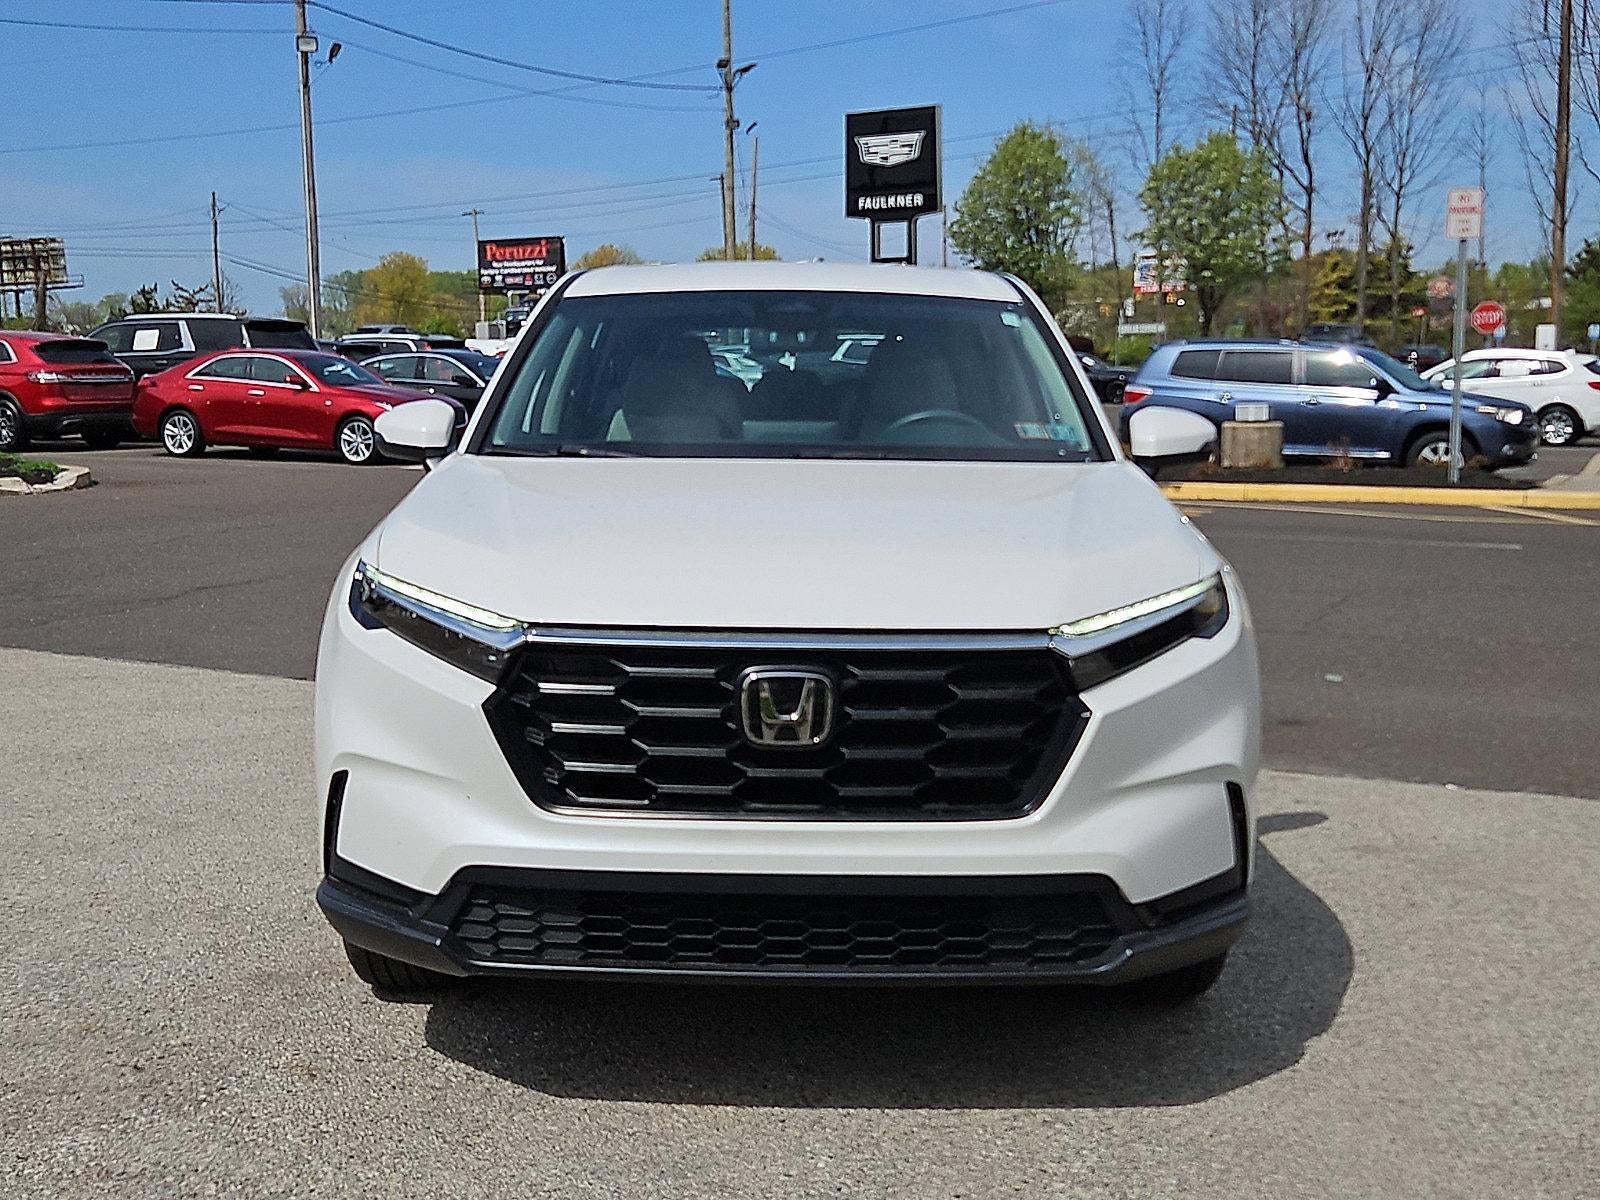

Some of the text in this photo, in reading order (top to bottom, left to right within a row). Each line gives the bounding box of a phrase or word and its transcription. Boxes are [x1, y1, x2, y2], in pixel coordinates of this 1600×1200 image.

[858, 193, 924, 210] FAULKNER
[485, 239, 549, 261] Peruzzi
[1473, 310, 1504, 326] STOP
